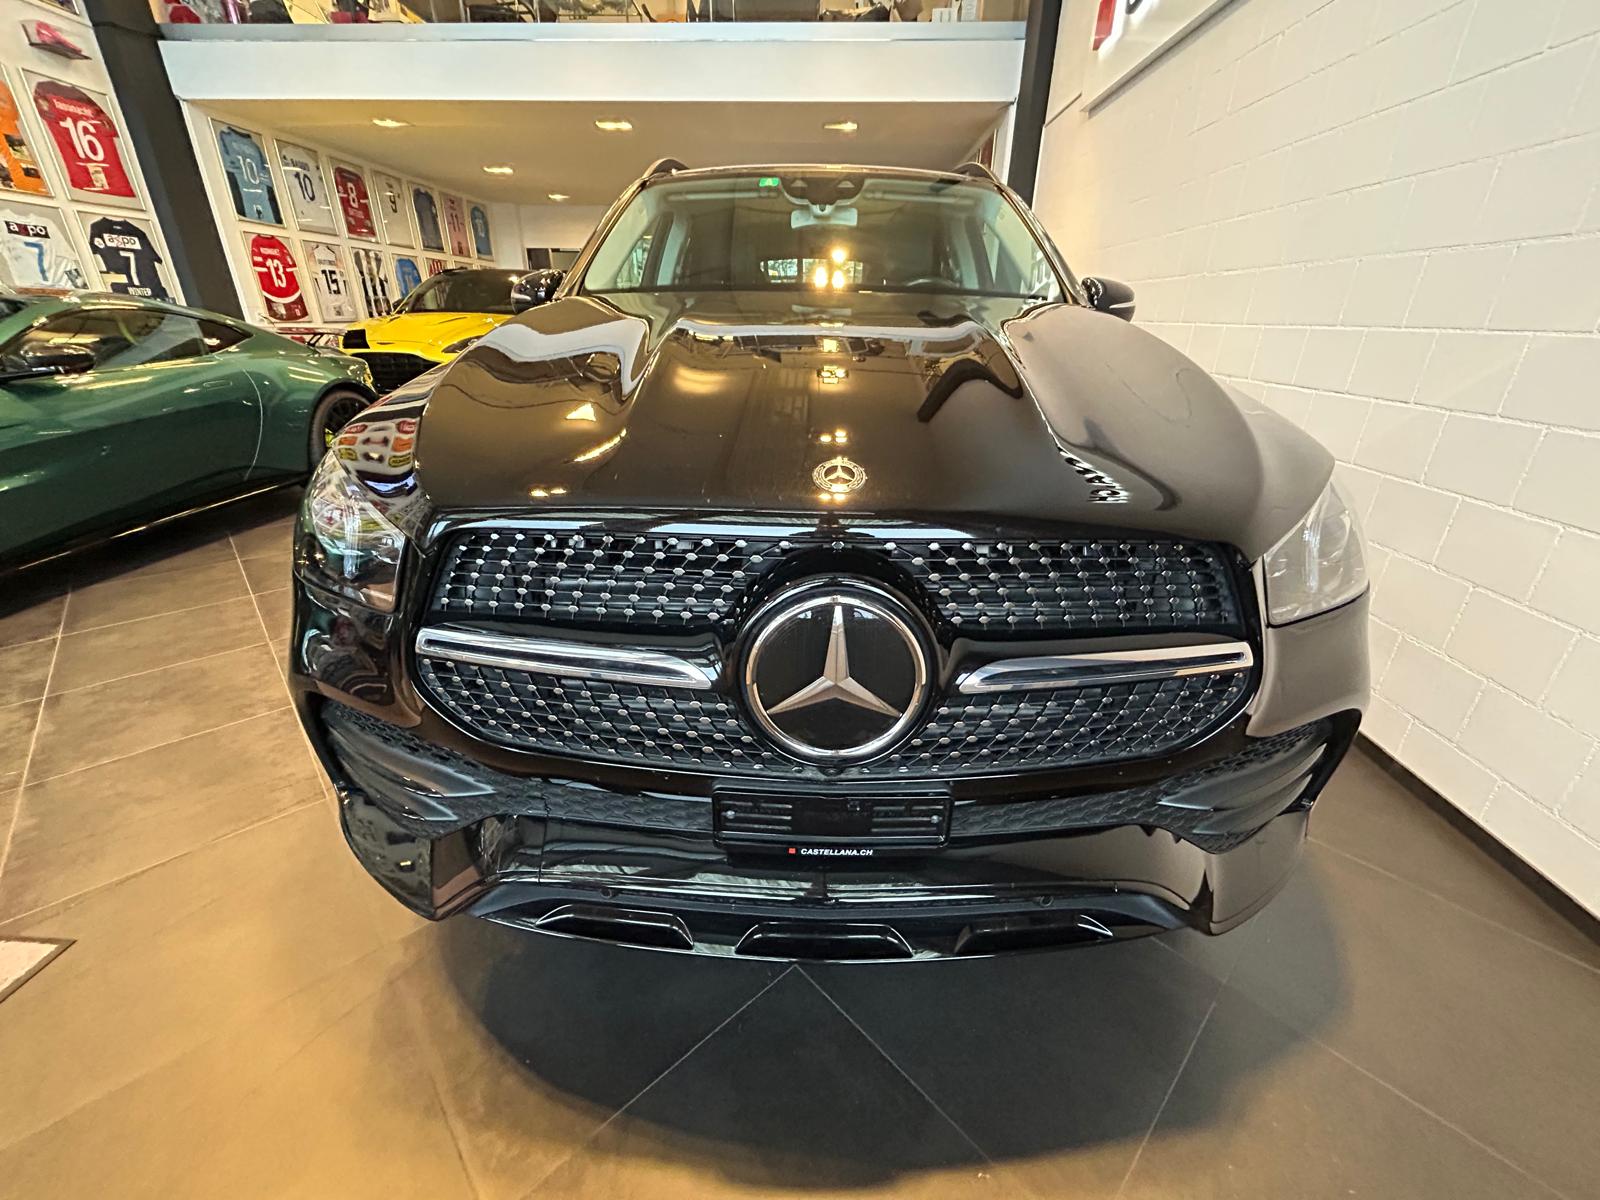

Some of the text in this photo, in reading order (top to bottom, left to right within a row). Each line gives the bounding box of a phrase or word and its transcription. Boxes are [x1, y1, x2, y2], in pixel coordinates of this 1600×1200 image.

[59, 117, 105, 162] 16
[236, 155, 260, 185] 10
[294, 171, 315, 201] 10
[347, 182, 359, 209] 8
[9, 222, 46, 236] apo
[23, 241, 49, 282] 7
[119, 250, 141, 287] 7
[265, 258, 287, 288] 13
[321, 269, 341, 295] 15
[800, 847, 874, 857] CASTELLANA.CH
